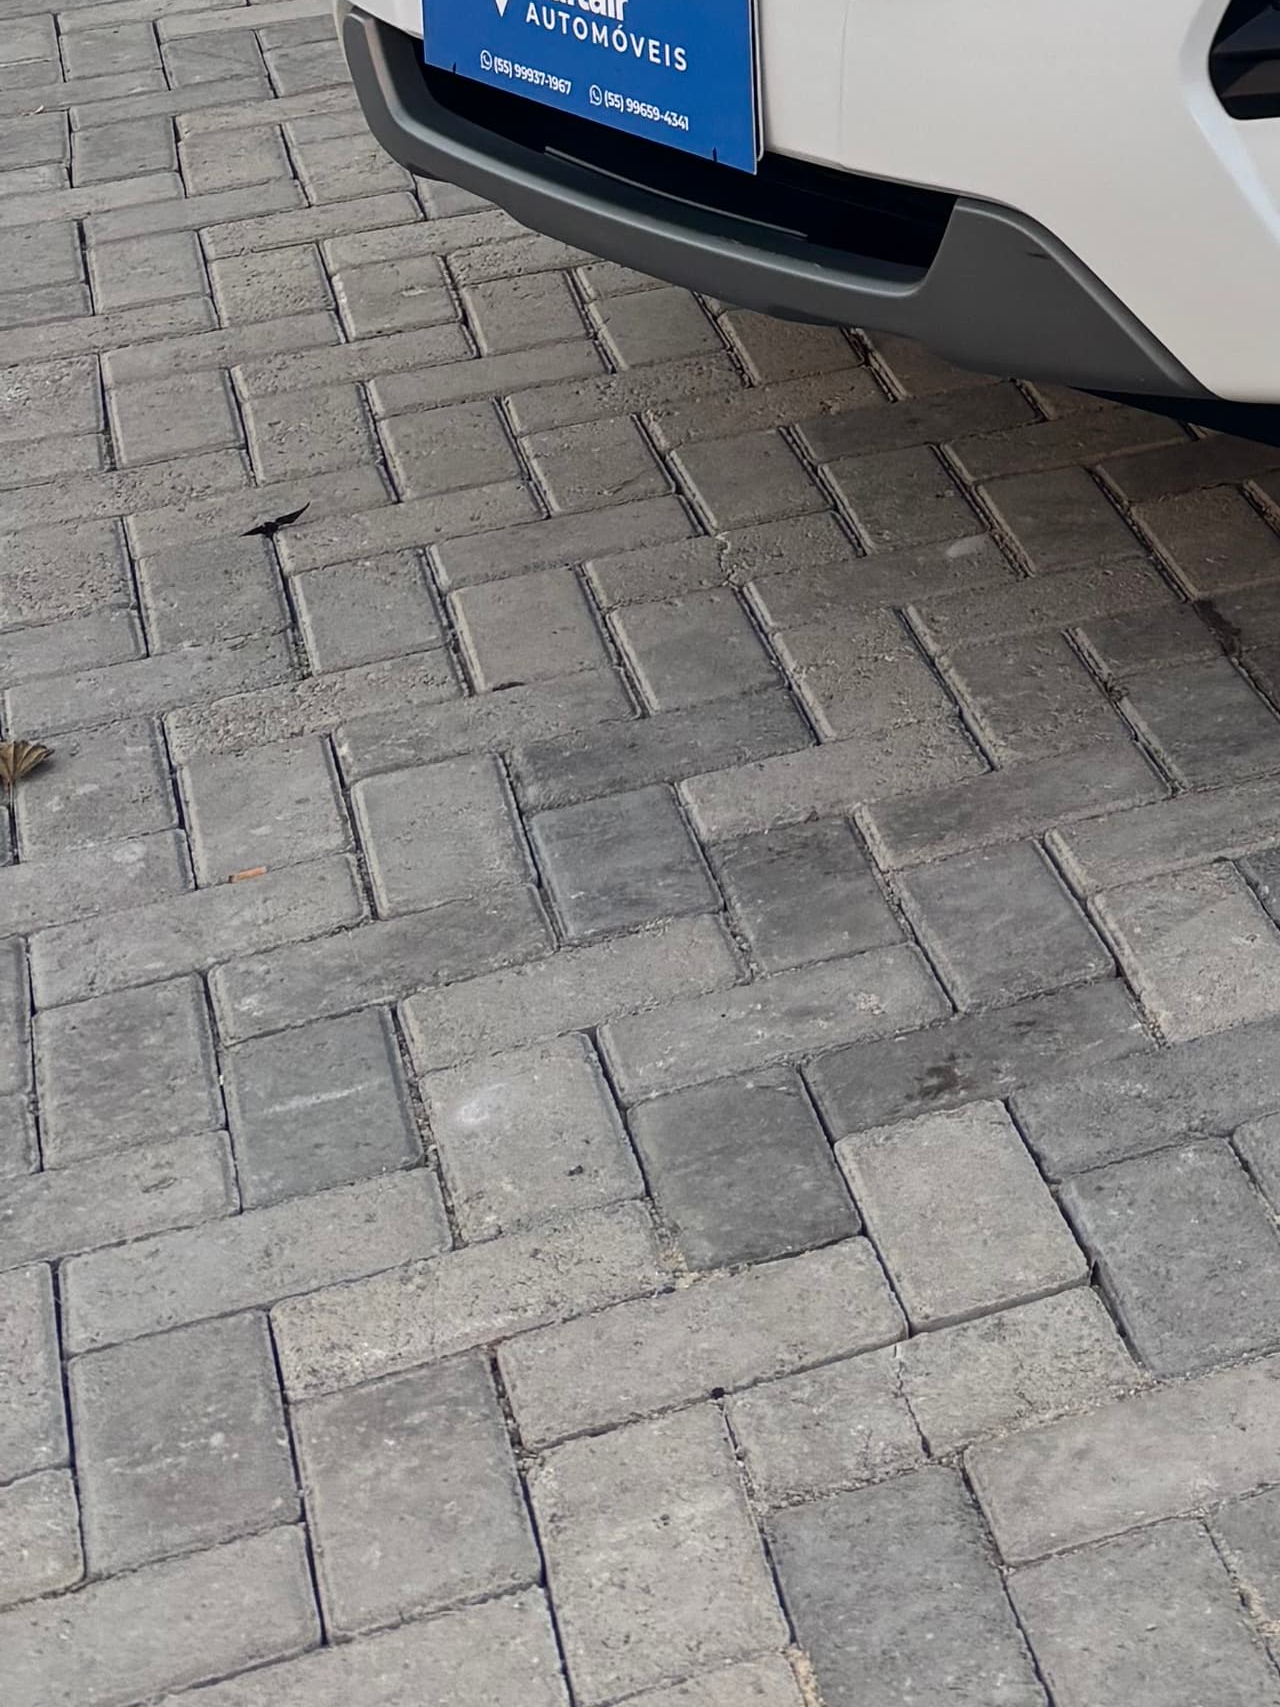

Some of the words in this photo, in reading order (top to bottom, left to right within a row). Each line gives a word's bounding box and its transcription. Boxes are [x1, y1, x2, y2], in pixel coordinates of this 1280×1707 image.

[525, 2, 688, 72] AUTOMÓVEIS
[493, 56, 513, 79] (55)
[514, 63, 572, 95] 99937-1967
[604, 90, 624, 113] (55)
[626, 98, 690, 131] 99659-4341
